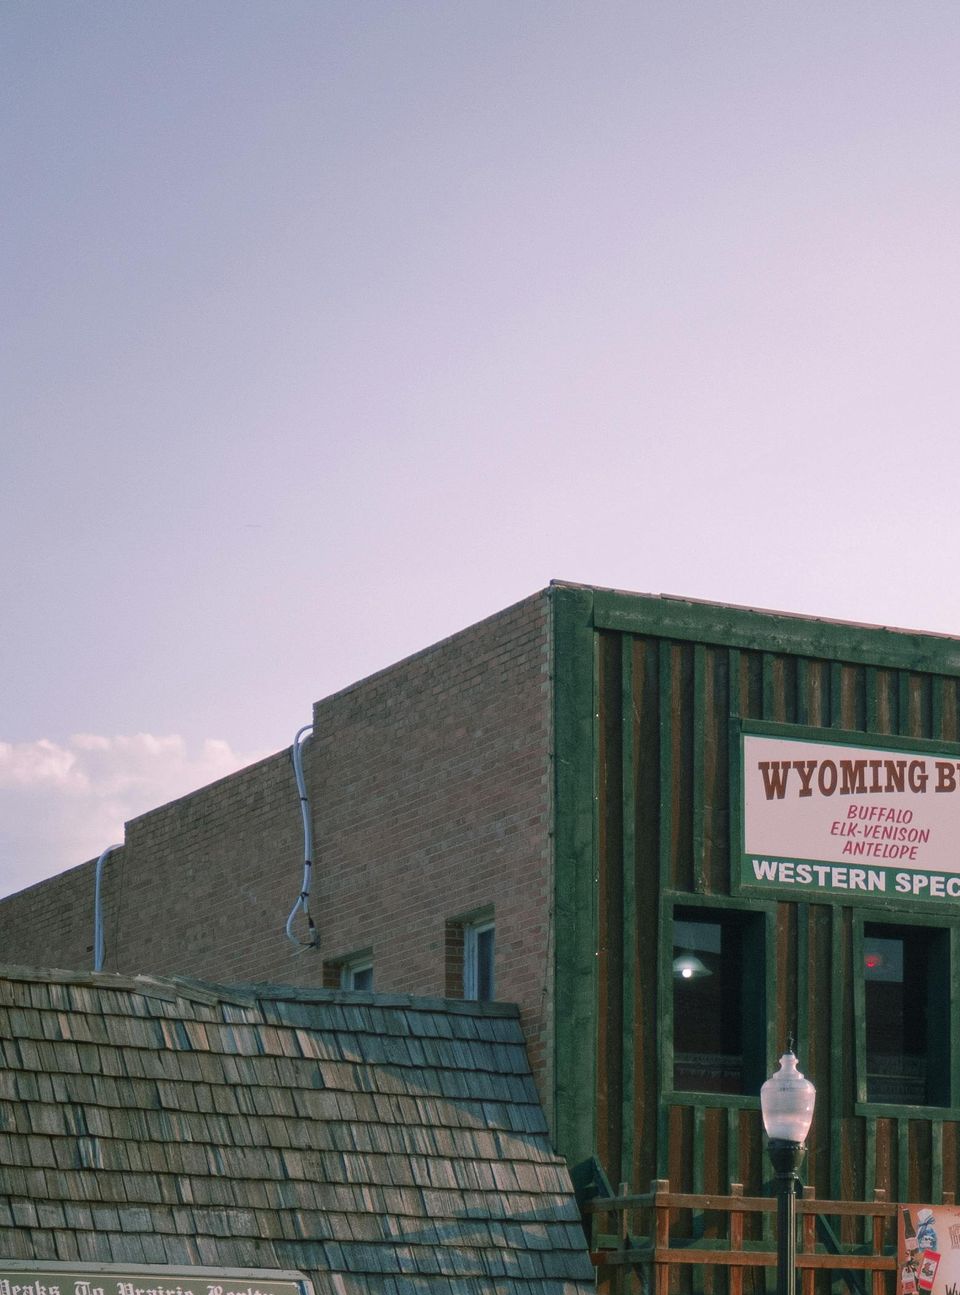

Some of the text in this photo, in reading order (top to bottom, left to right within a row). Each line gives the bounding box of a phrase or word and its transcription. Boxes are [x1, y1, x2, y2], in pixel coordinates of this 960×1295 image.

[758, 760, 929, 801] WYOMING
[847, 805, 913, 825] BUFFALO
[830, 822, 931, 844] ELK-VENISON
[842, 840, 918, 861] ANTELOPE
[752, 859, 887, 892] WESTERN
